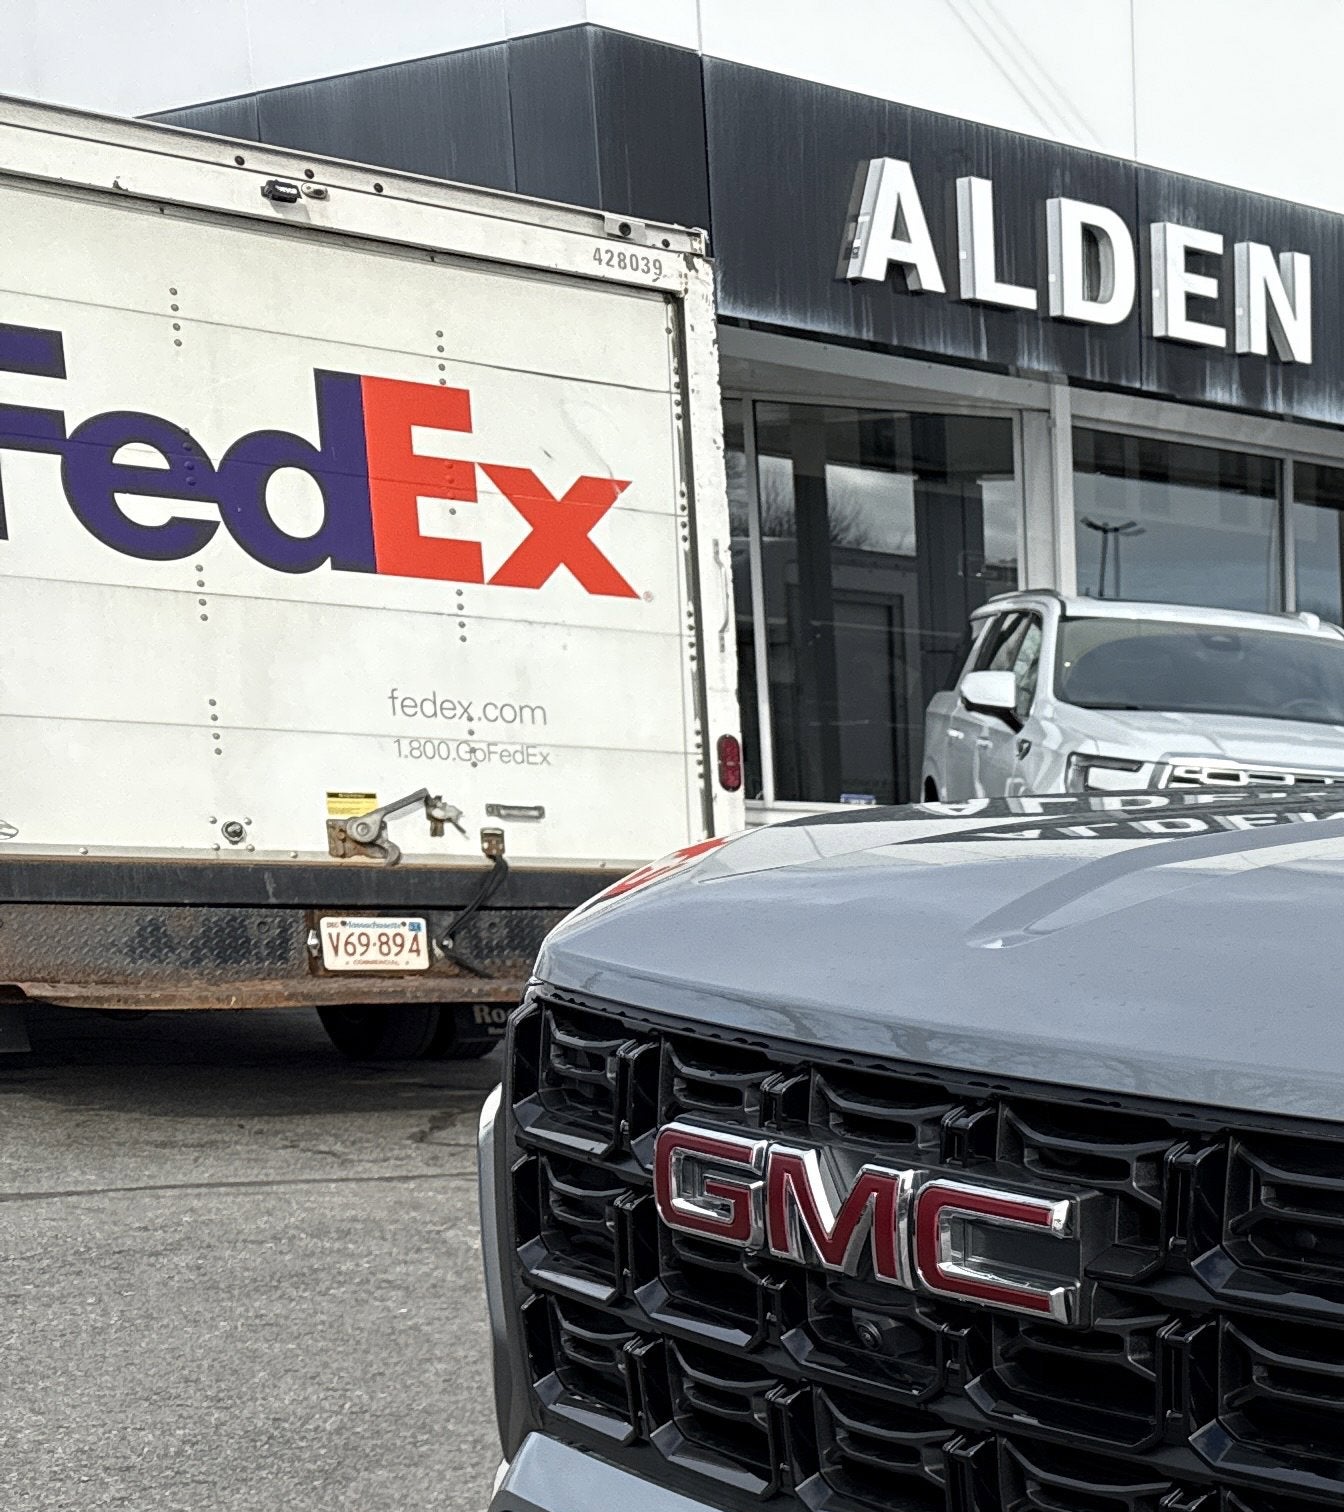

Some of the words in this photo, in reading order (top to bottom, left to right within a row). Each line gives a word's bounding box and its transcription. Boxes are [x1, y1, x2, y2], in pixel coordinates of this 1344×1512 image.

[593, 247, 663, 278] 428039
[847, 156, 1312, 364] ALDEN
[388, 687, 547, 726] fedex.com
[394, 738, 551, 766] 1.800.GoFedEx
[653, 1121, 1079, 1325] GMC
